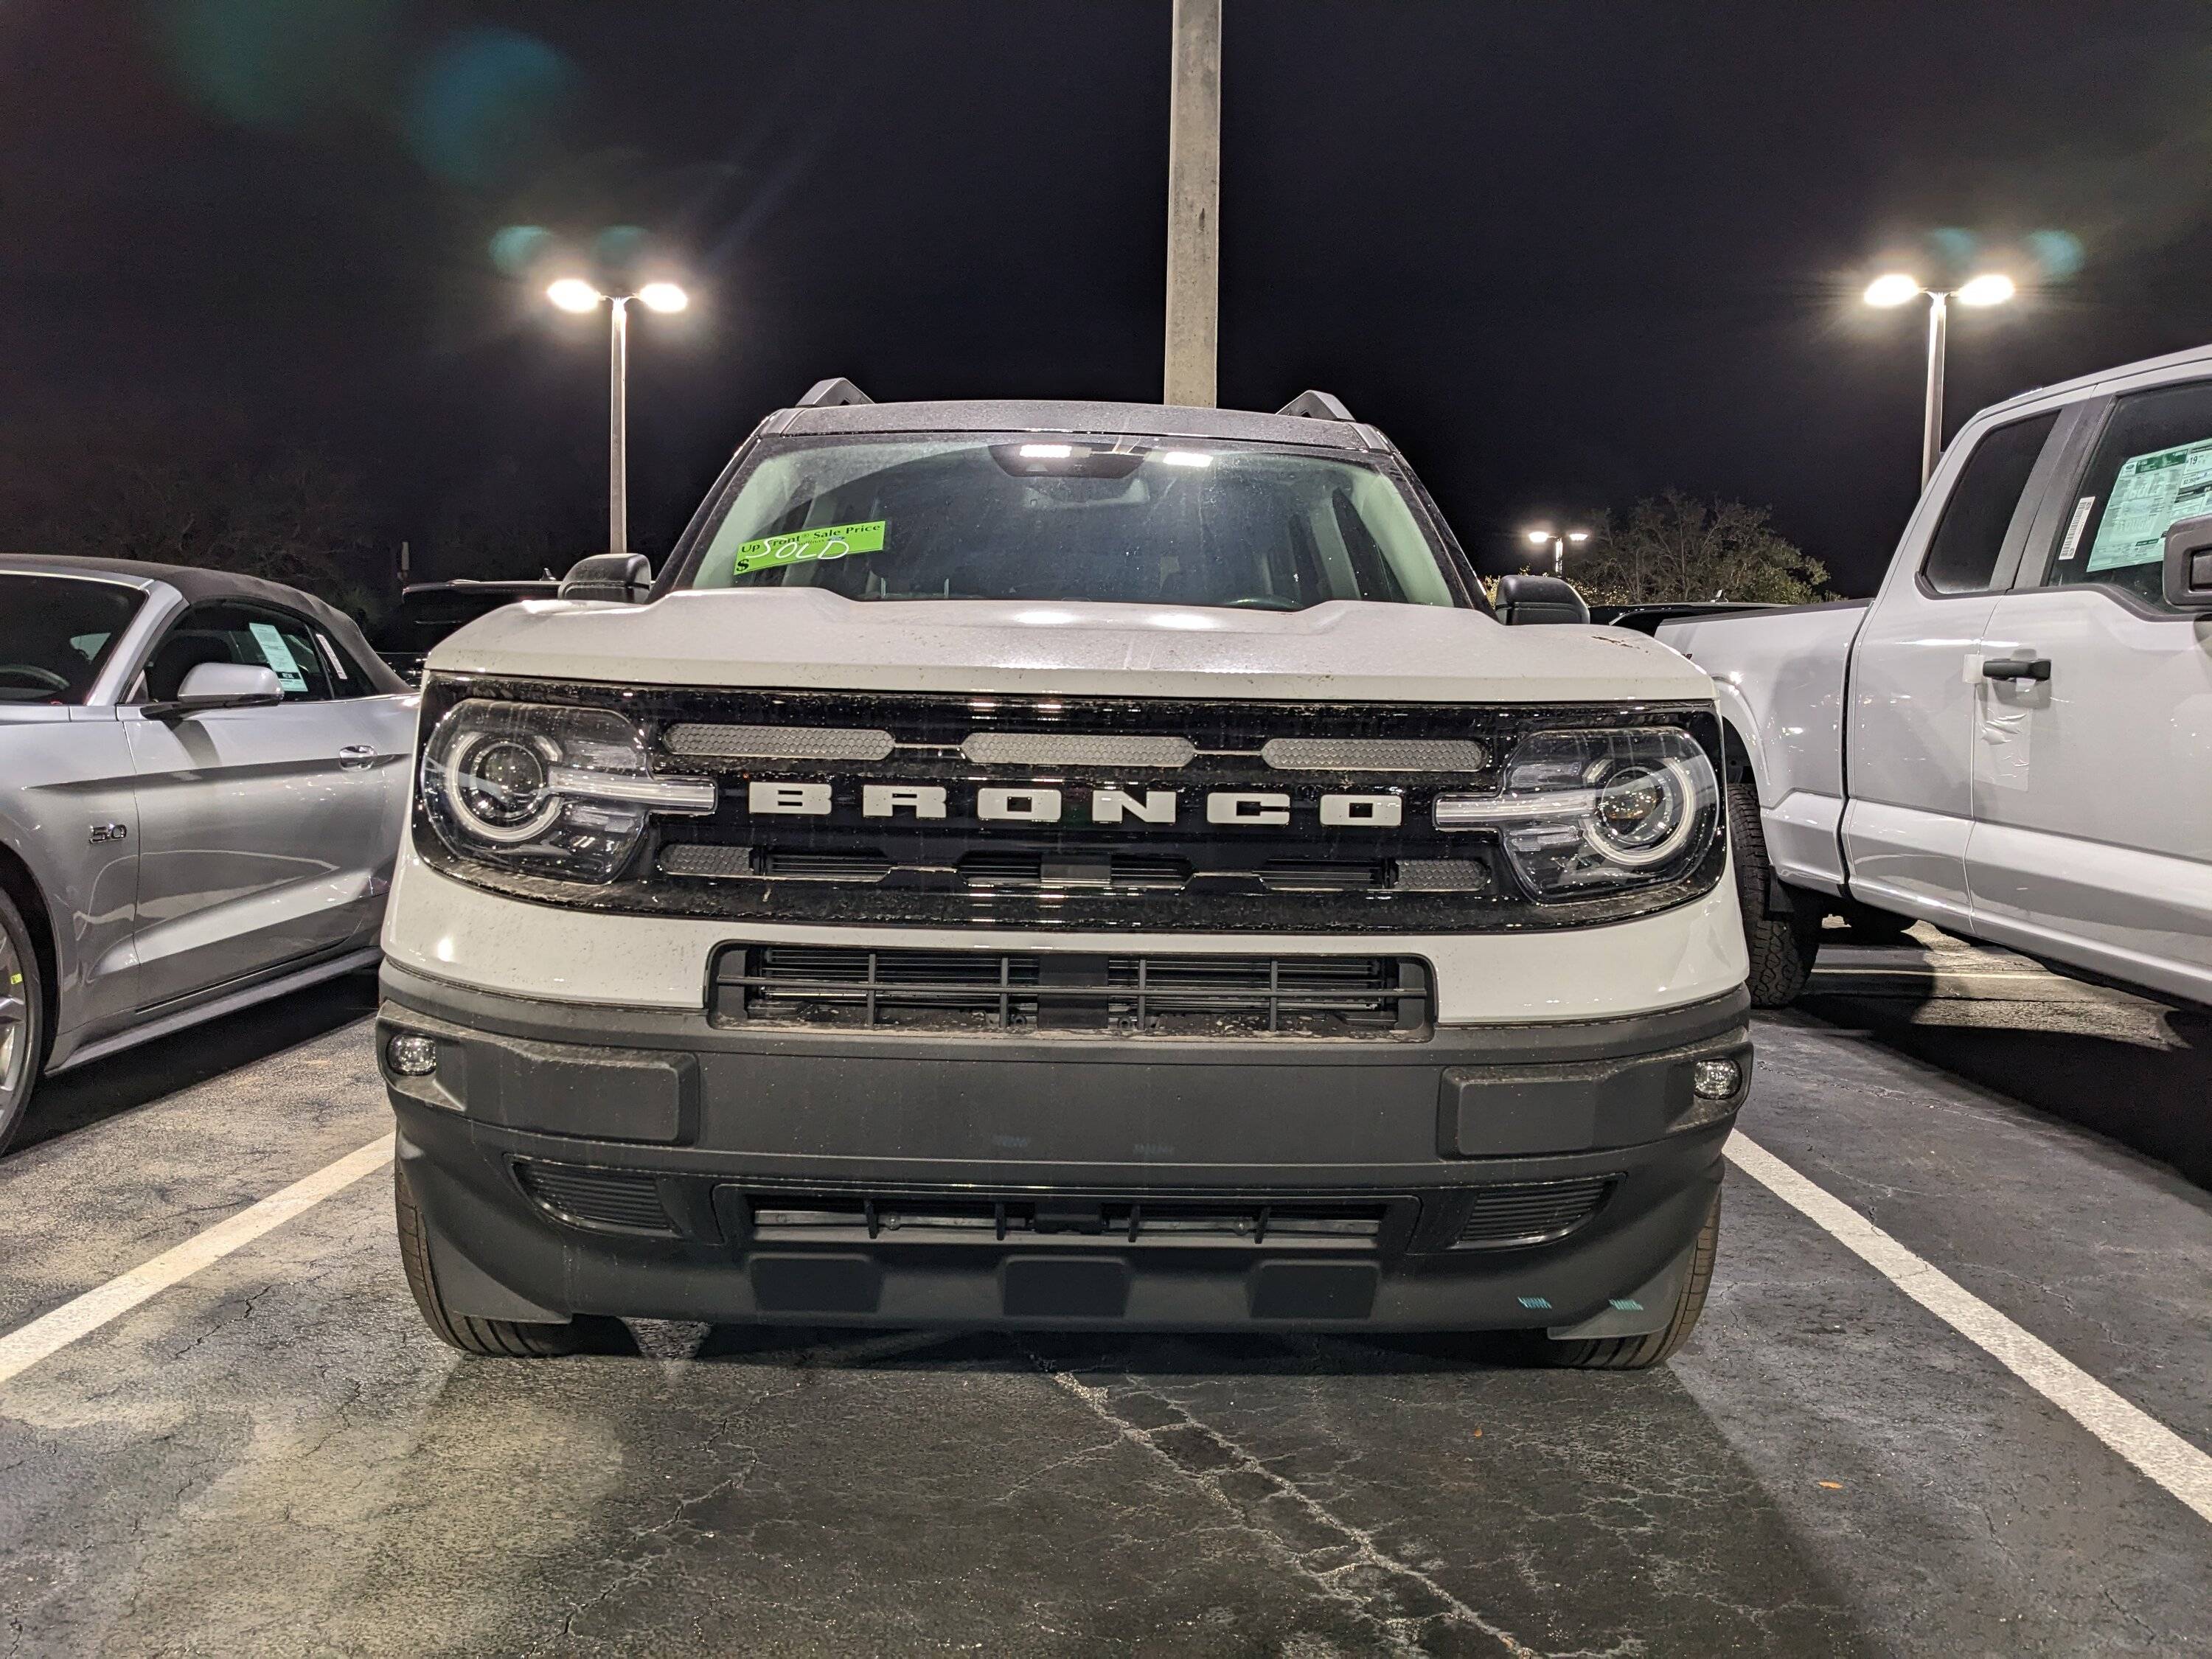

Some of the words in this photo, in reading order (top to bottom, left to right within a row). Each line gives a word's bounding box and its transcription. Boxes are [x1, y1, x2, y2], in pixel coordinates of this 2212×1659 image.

[742, 544, 760, 552] Up
[768, 535, 800, 547] ront
[813, 529, 841, 539] Sale
[846, 524, 881, 535] Price
[745, 537, 849, 560] SOLD
[737, 558, 749, 571] $
[748, 782, 1402, 826] BRONCO
